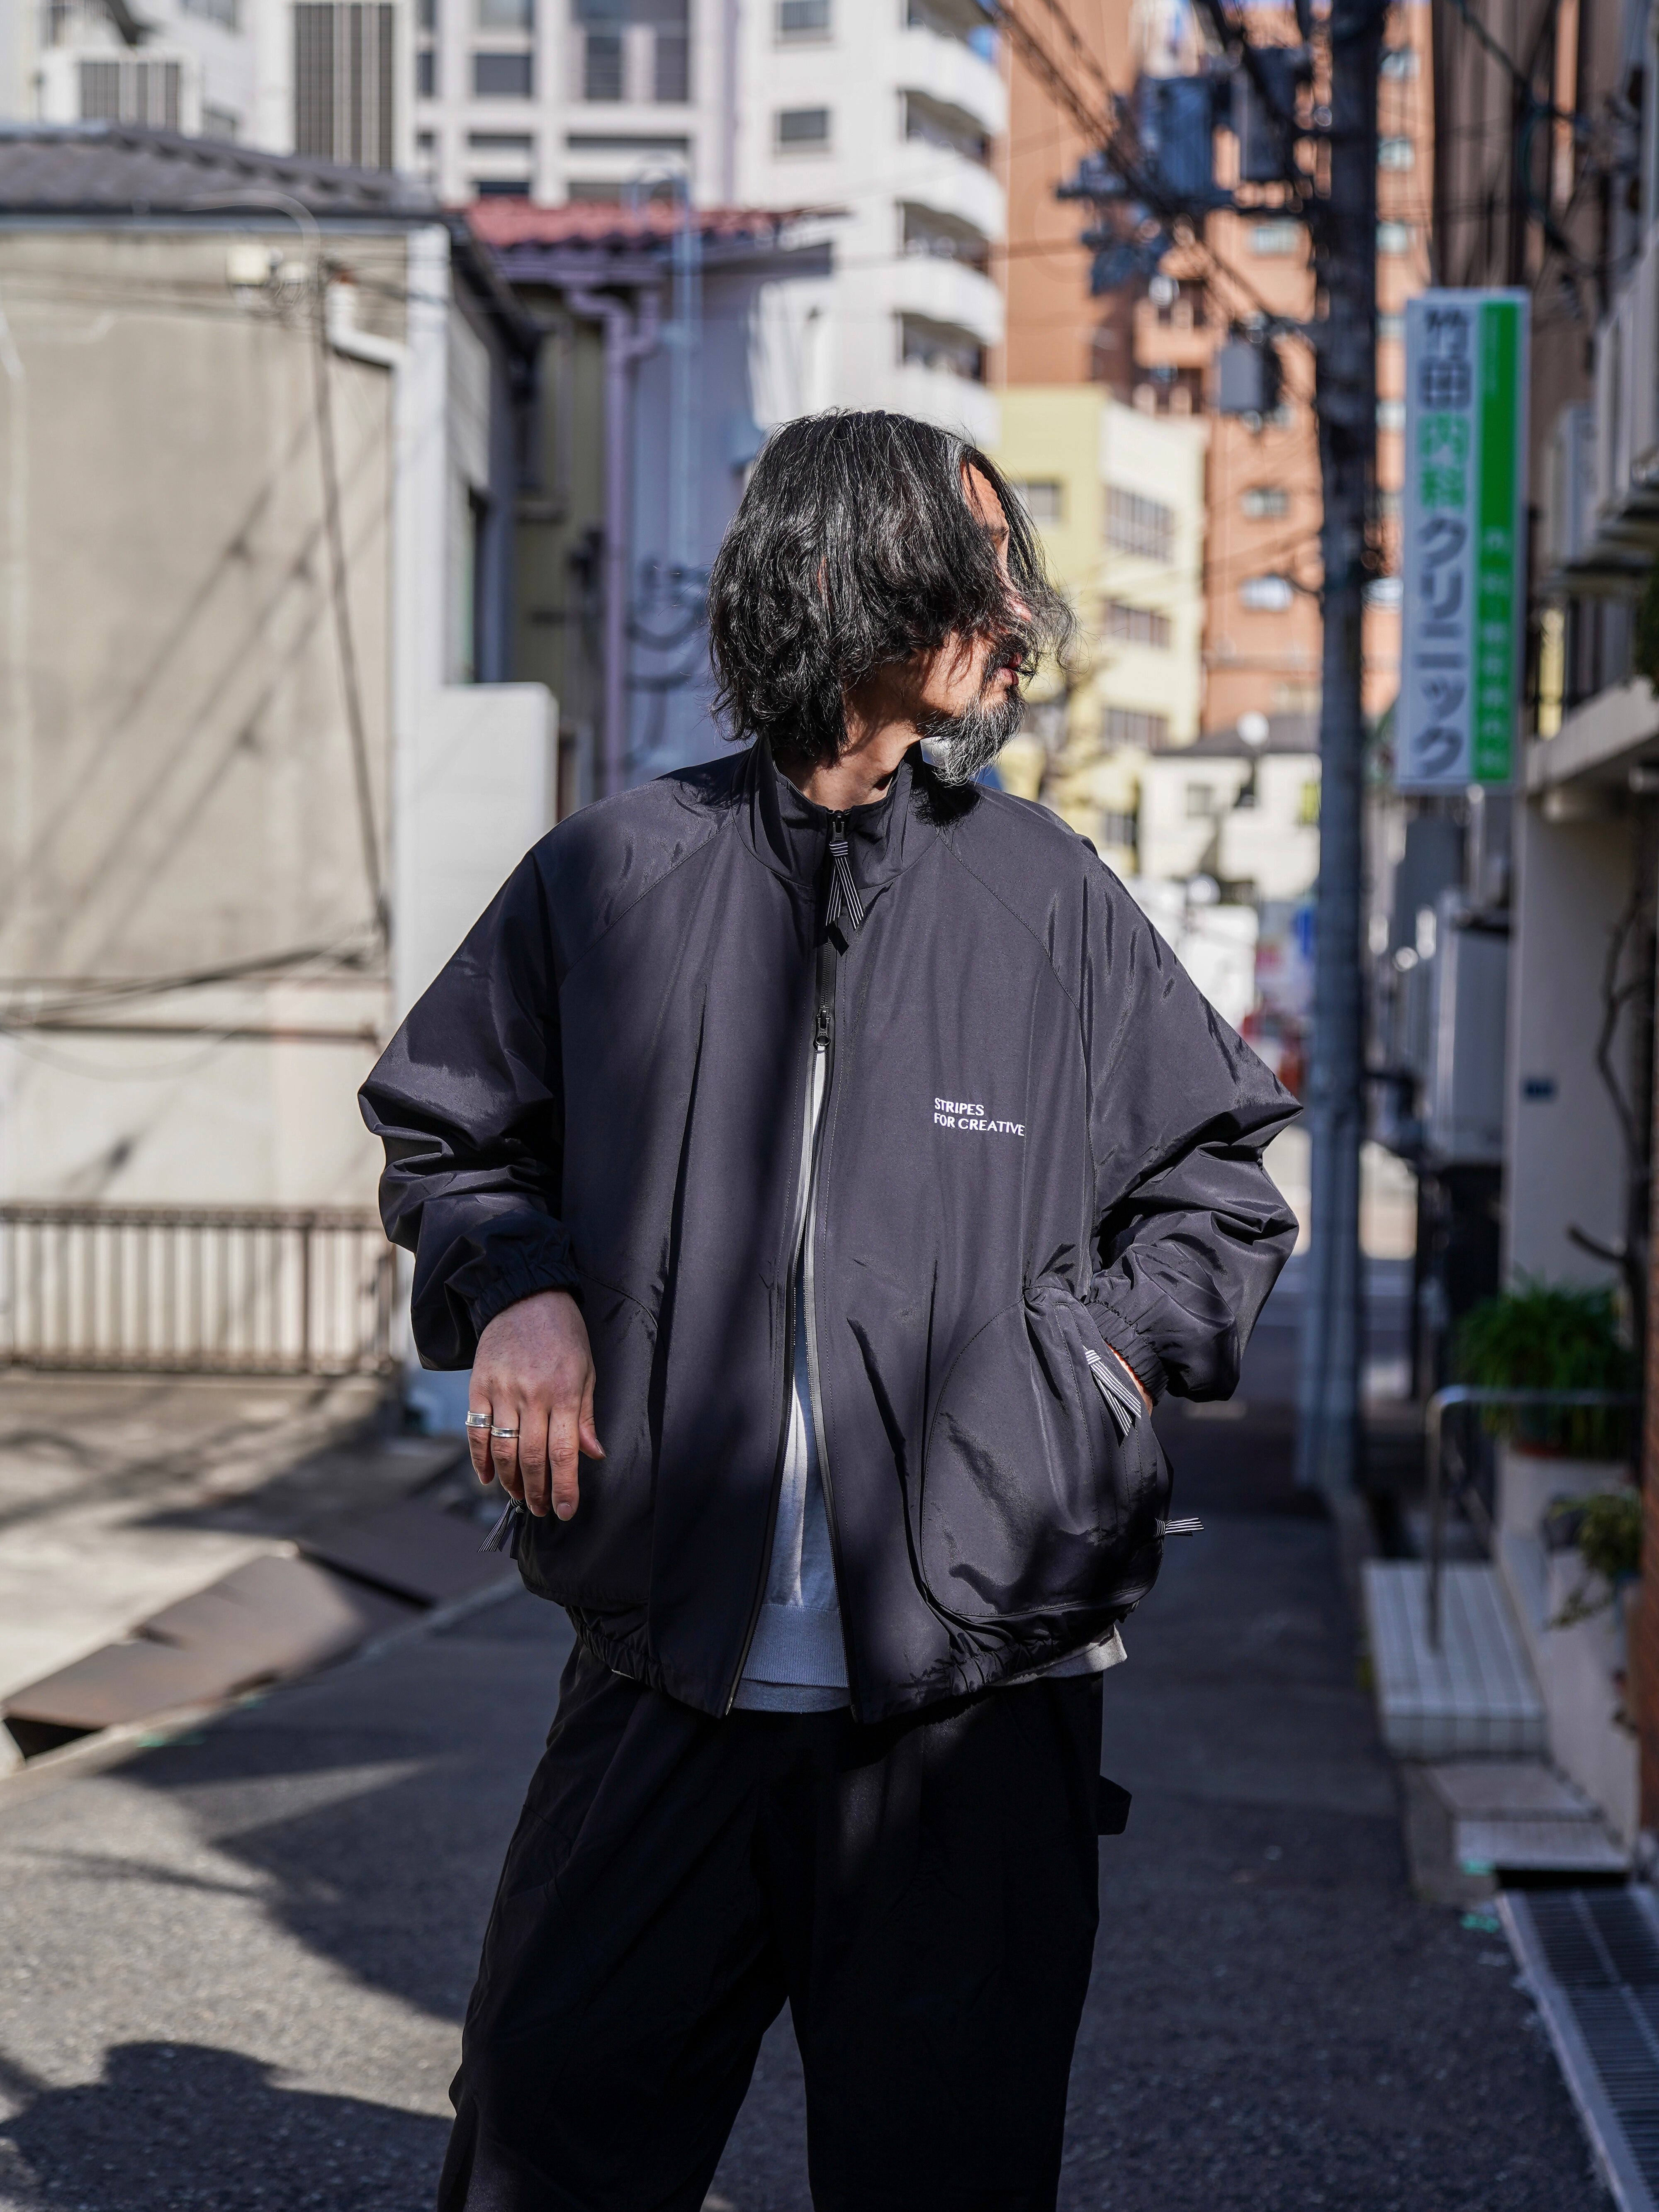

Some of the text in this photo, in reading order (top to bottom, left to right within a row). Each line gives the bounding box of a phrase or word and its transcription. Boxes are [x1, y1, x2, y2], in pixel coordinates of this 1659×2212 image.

[934, 1097, 984, 1116] STRIPES
[934, 1112, 1025, 1136] FOR CREATIVE
